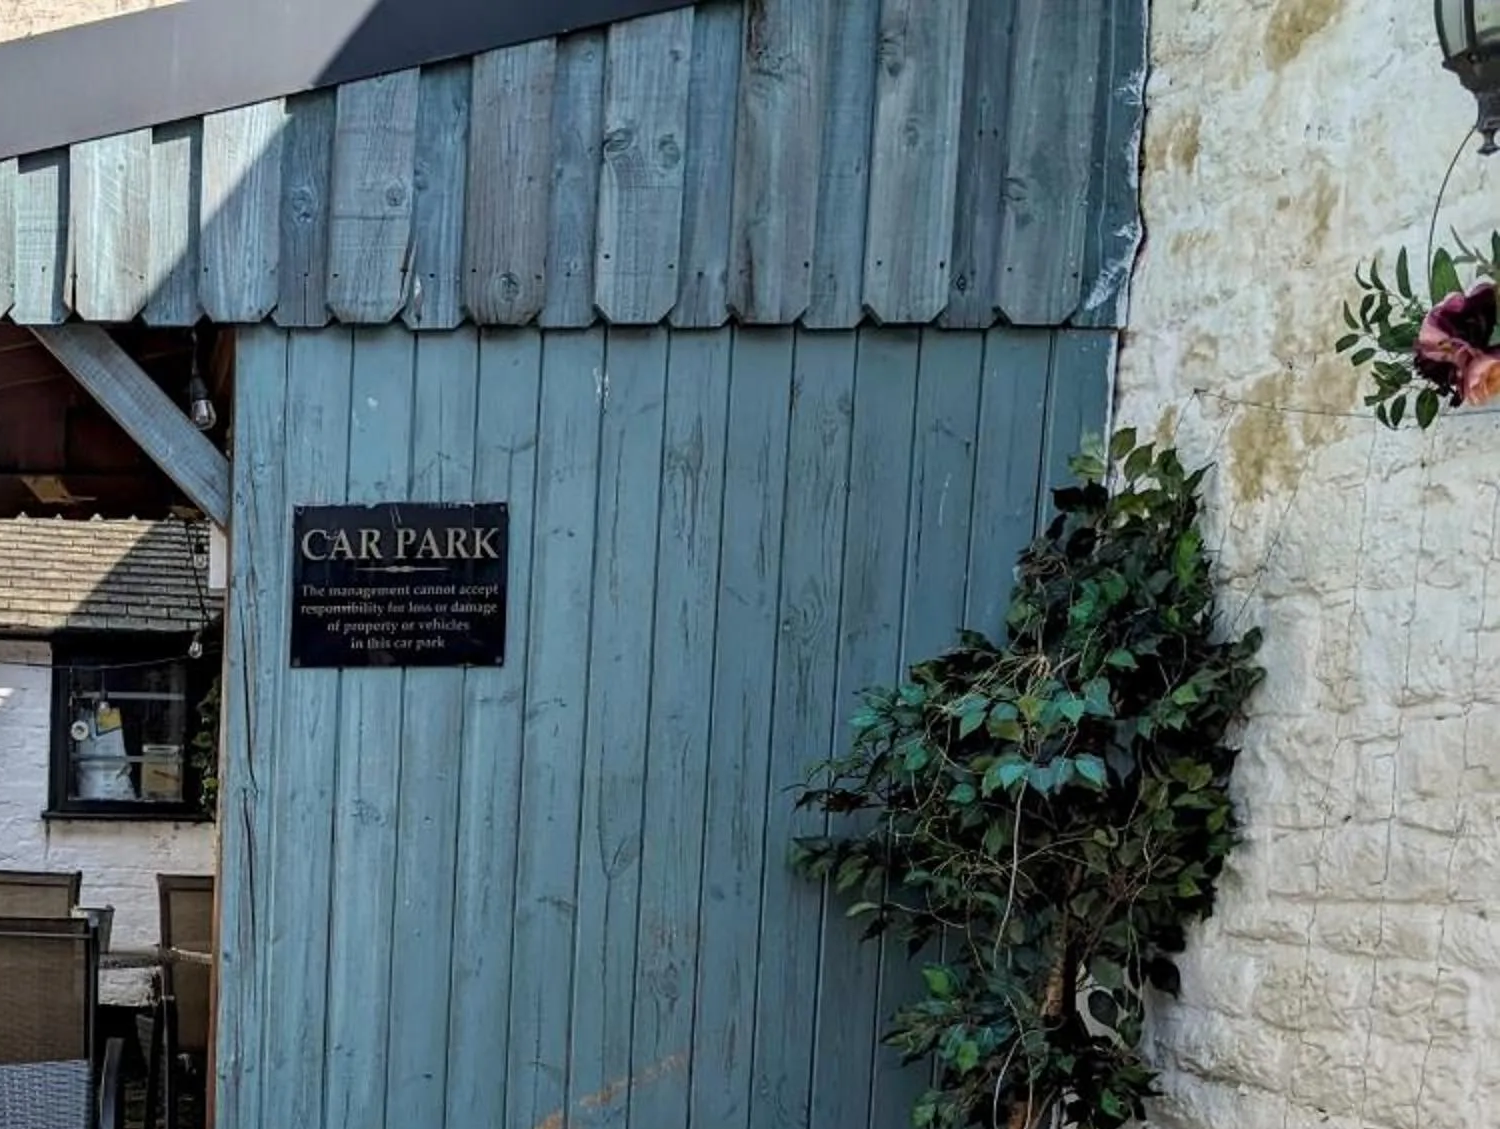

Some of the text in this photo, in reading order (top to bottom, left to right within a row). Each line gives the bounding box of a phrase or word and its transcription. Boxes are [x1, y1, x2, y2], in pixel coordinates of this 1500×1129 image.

[302, 527, 499, 561] CAR PARK
[302, 584, 499, 599] The management cannot accept
[300, 601, 498, 616] responsibility for loss or damage
[327, 618, 470, 634] of property or vehicles
[350, 636, 445, 650] in this car park
